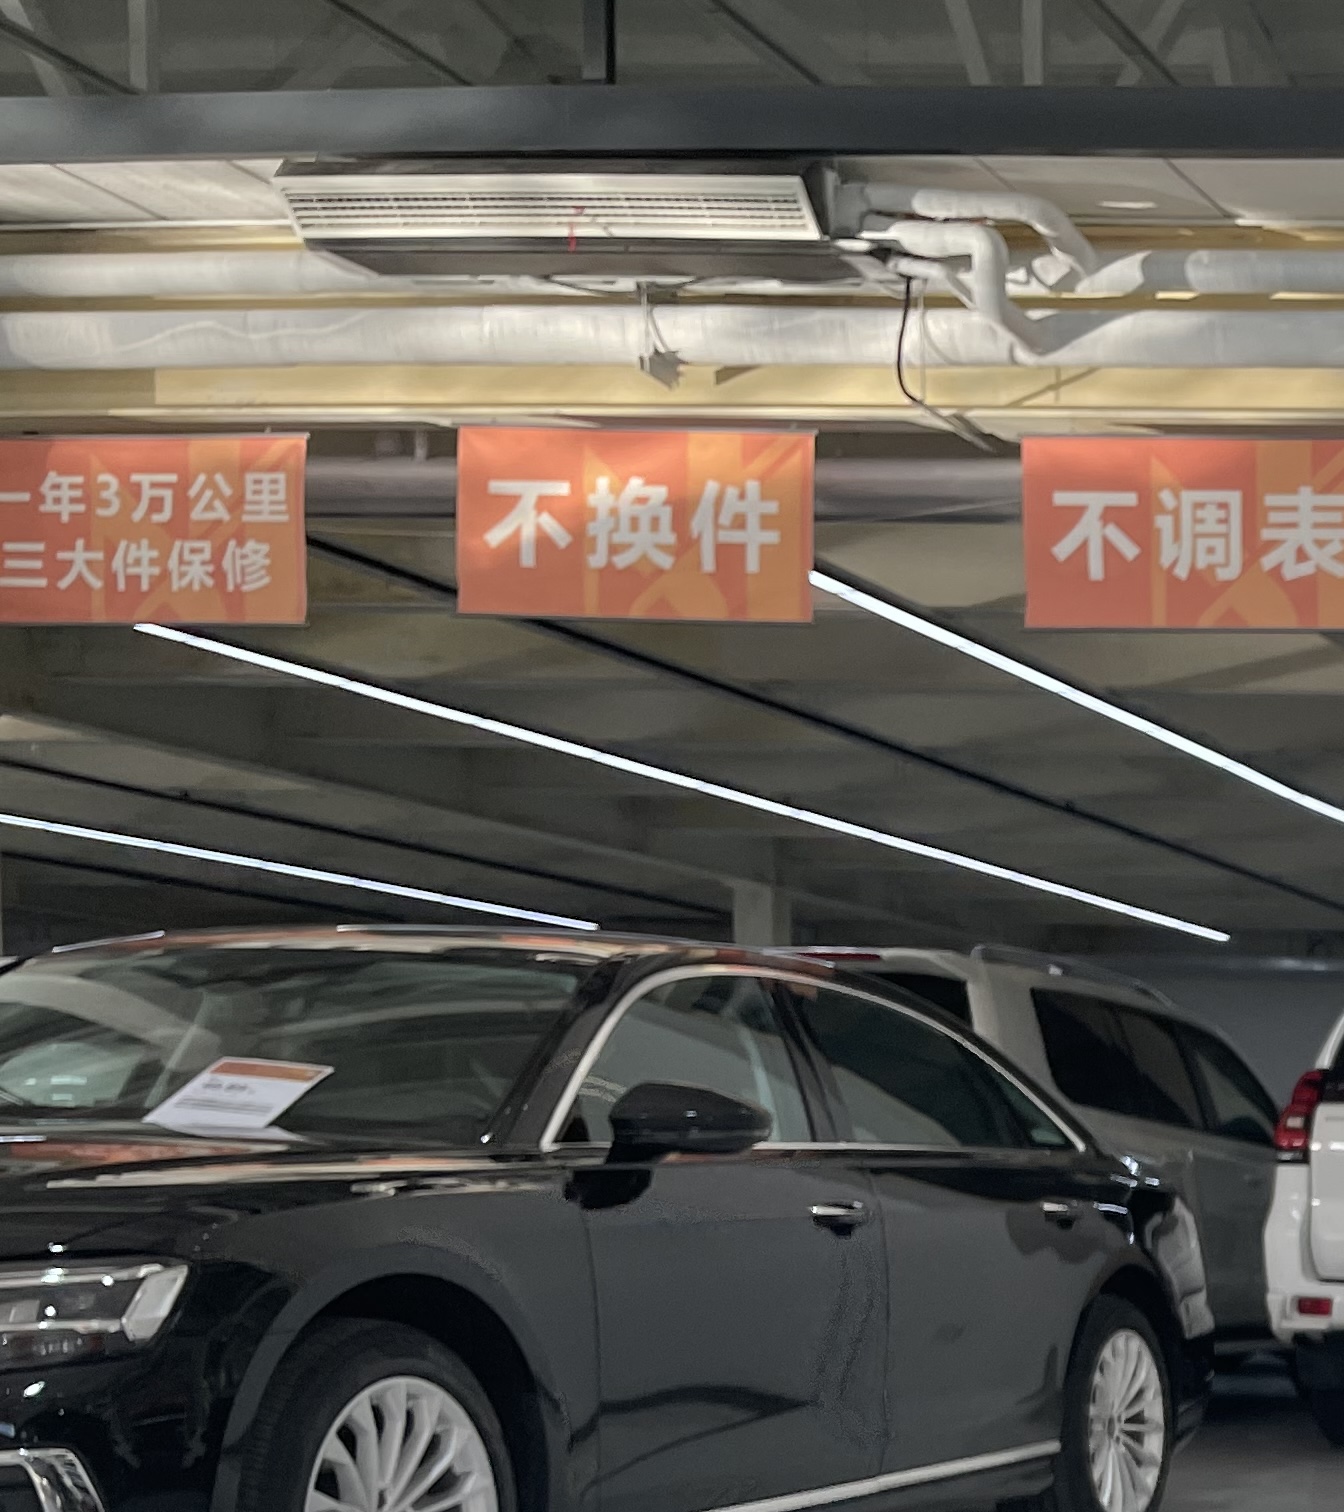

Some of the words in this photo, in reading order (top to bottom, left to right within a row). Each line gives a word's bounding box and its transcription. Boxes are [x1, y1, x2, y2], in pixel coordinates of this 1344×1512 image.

[0, 470, 290, 524] 一年3万公里
[484, 476, 782, 574] 不换件
[0, 537, 272, 592] 三大件保修
